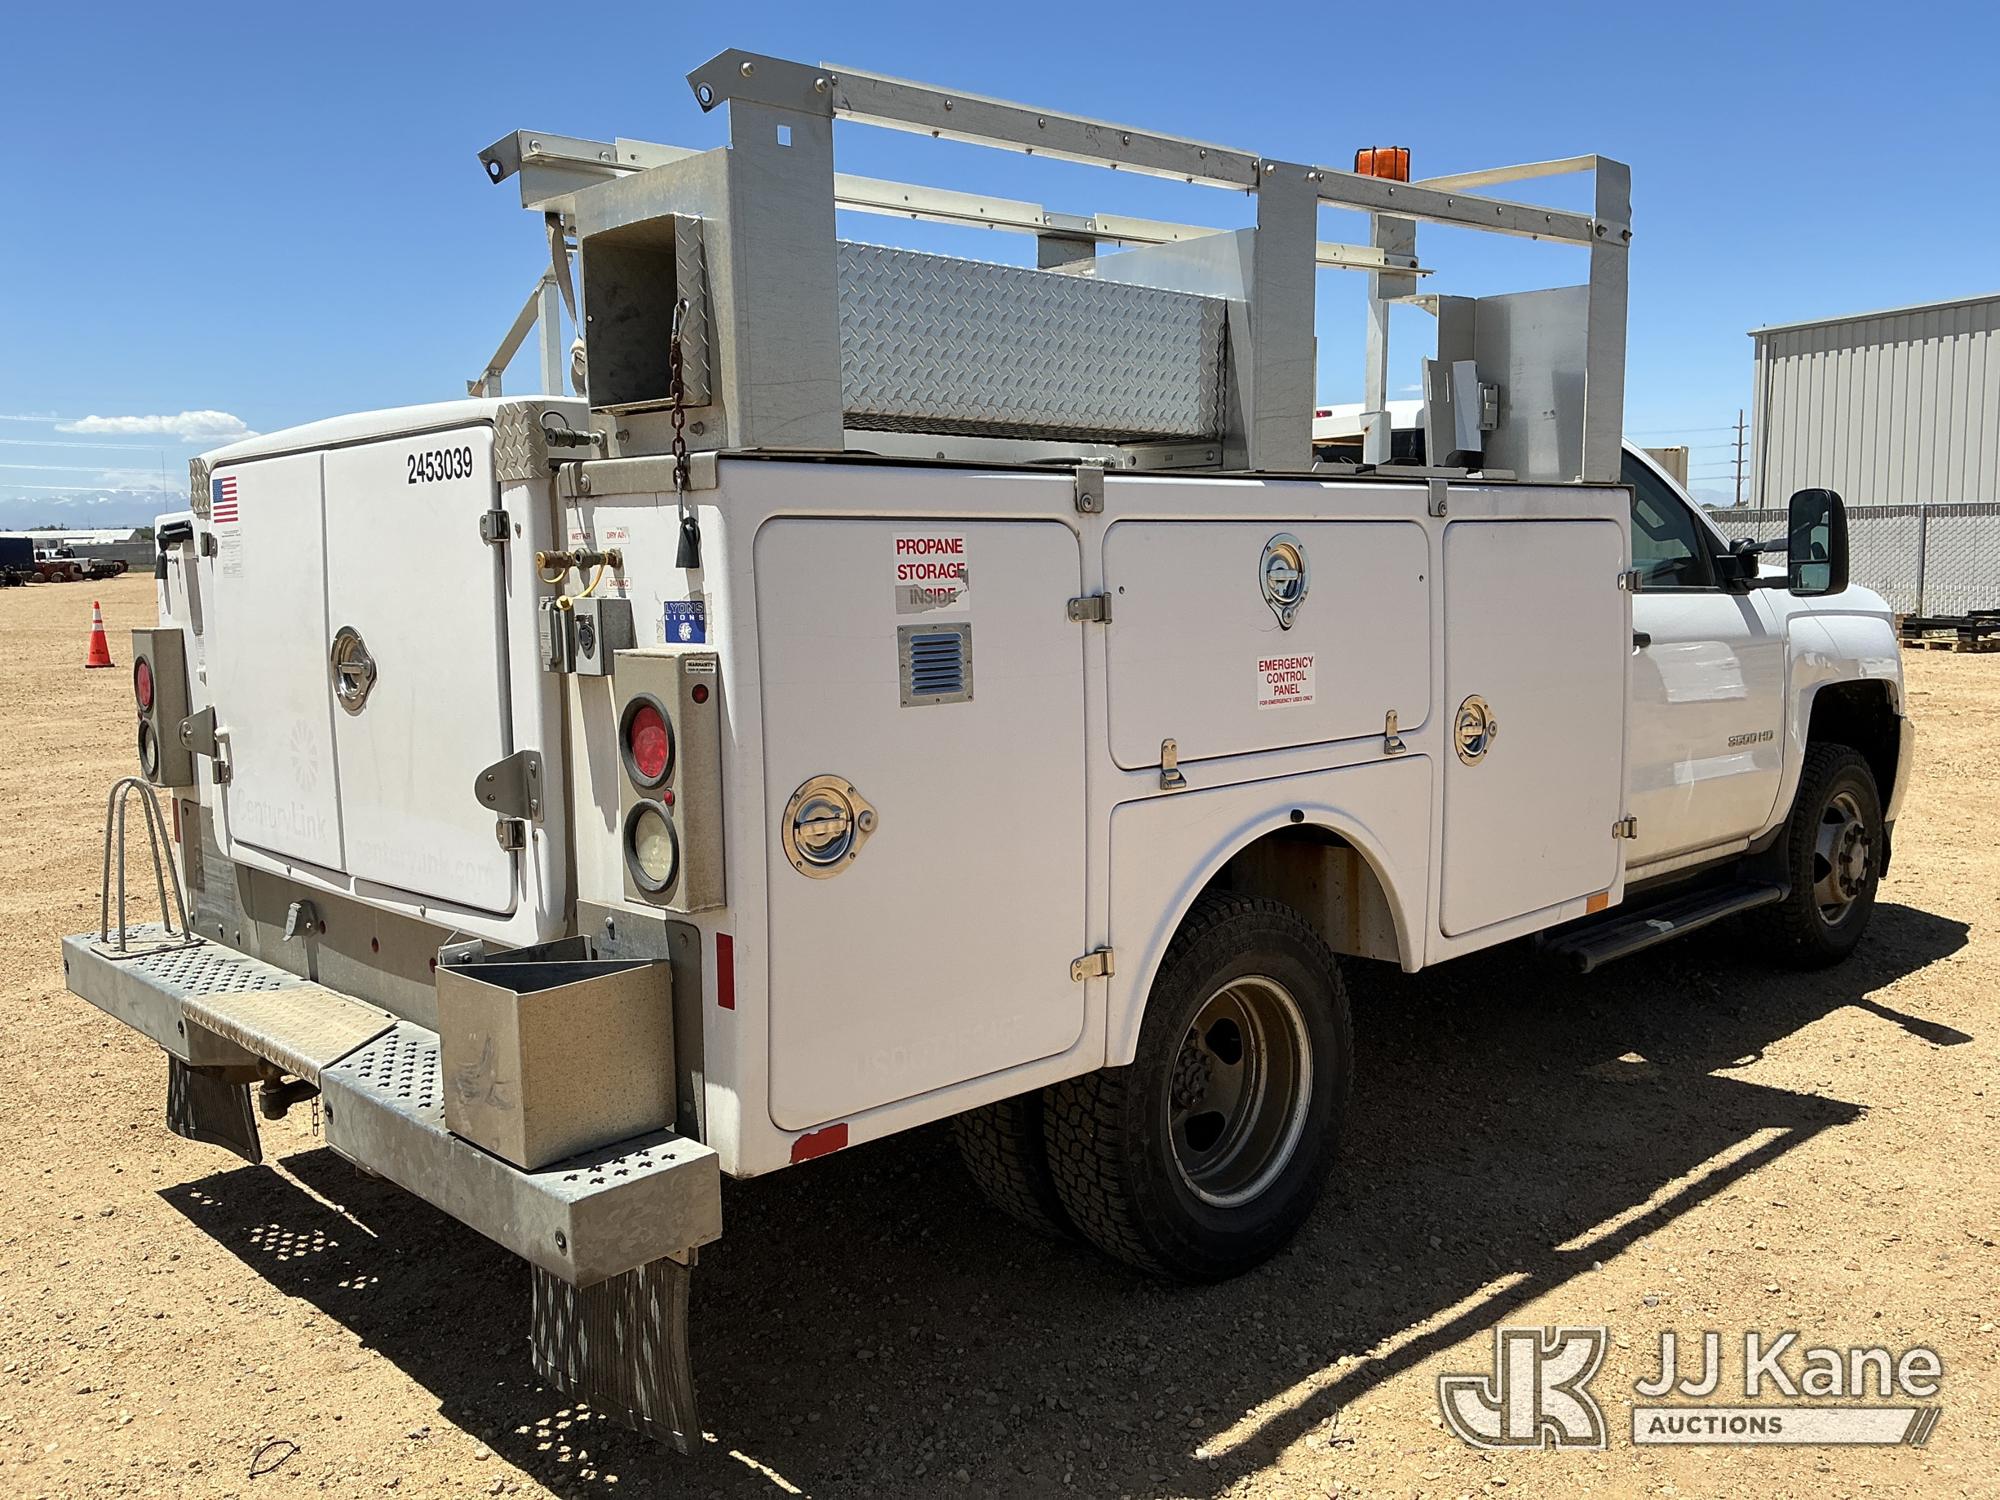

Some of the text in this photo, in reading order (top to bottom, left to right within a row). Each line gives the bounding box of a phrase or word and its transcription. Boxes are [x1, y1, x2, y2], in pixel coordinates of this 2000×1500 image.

[407, 446, 473, 484] 2453039
[606, 531, 617, 539] DRY
[896, 538, 963, 555] PROPANE
[898, 562, 965, 580] STORAGE
[910, 587, 956, 604] INSIDE
[665, 603, 704, 613] LYONS
[1259, 656, 1313, 672] EMERGENCY
[1267, 671, 1306, 684] CONTROL
[1274, 684, 1300, 696] PANEL
[1758, 730, 1774, 742] HD
